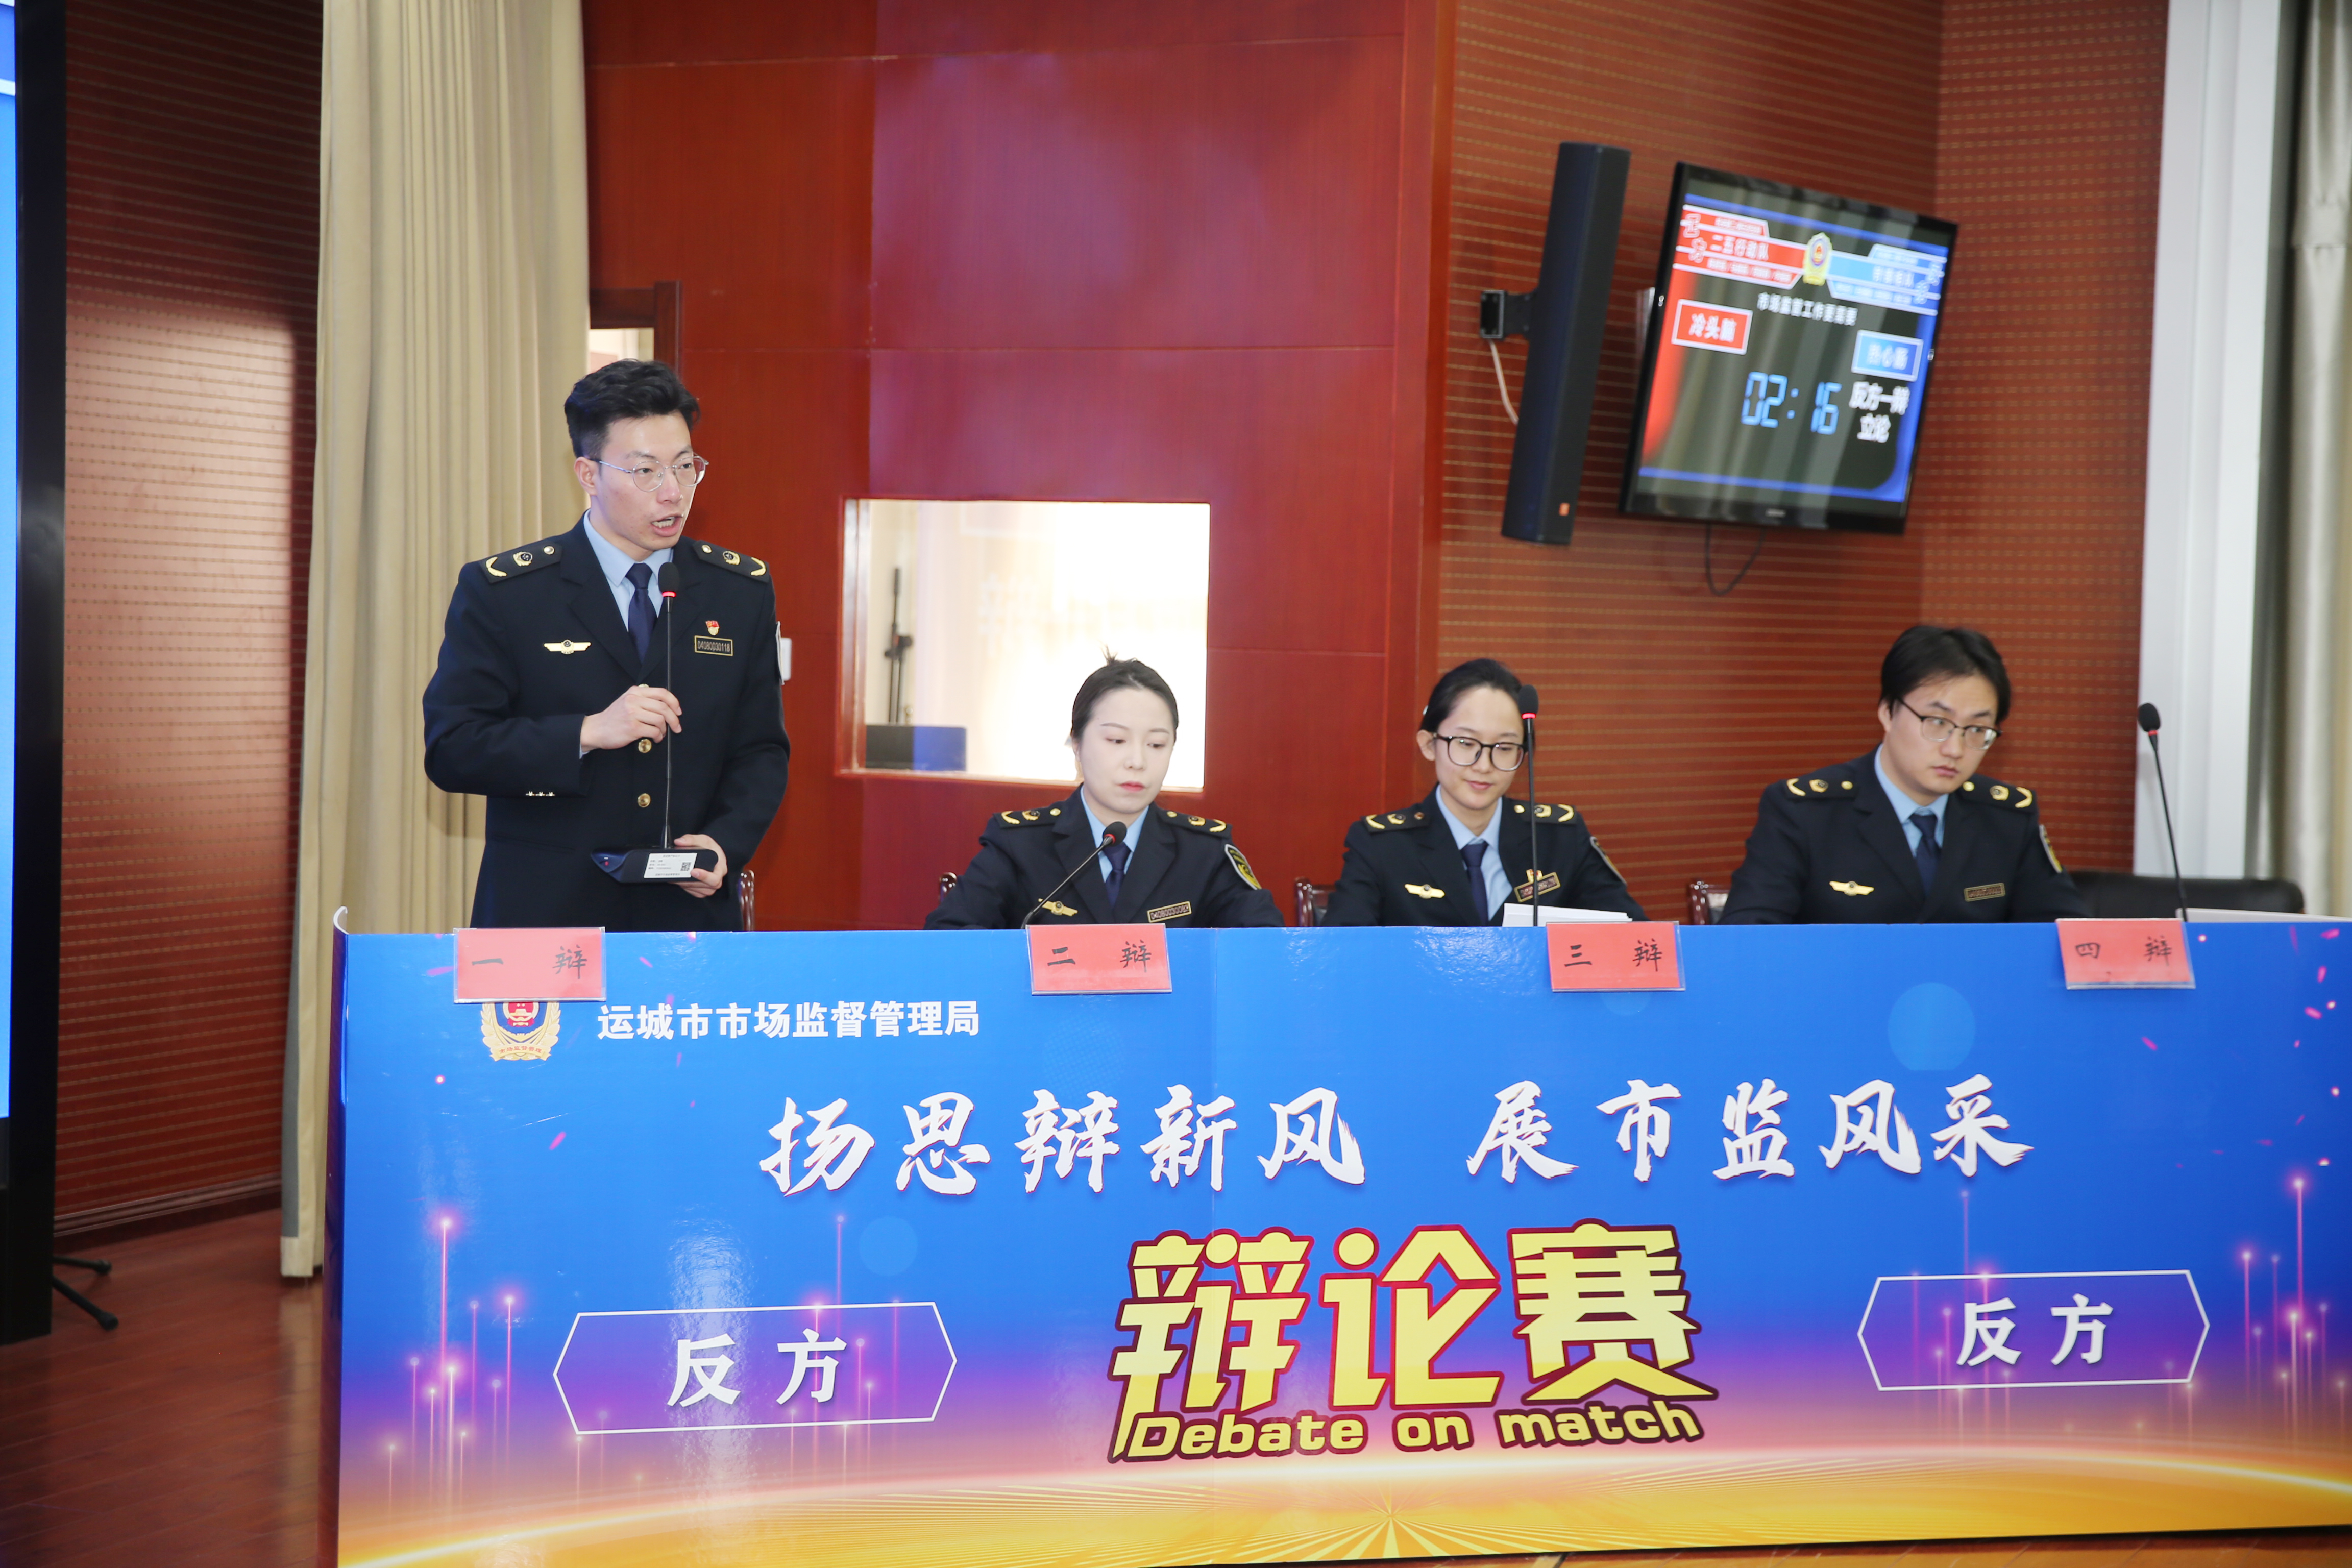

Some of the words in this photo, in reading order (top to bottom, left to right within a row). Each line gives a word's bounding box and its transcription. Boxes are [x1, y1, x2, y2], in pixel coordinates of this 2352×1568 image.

[1741, 372, 1842, 435] 02:16
[499, 1045, 542, 1055] 市场监督管理
[597, 1000, 979, 1041] 运城市市场监督管理局
[760, 1084, 1366, 1196] 扬思辩新风
[1466, 1074, 2034, 1183] 展市监风采
[1112, 1221, 1716, 1461] 辩论赛
[1956, 1293, 2113, 1366] 反方
[667, 1328, 847, 1407] 反方
[1126, 1411, 1365, 1459] Debate
[1396, 1414, 1470, 1450] on
[1498, 1399, 1700, 1448] match
